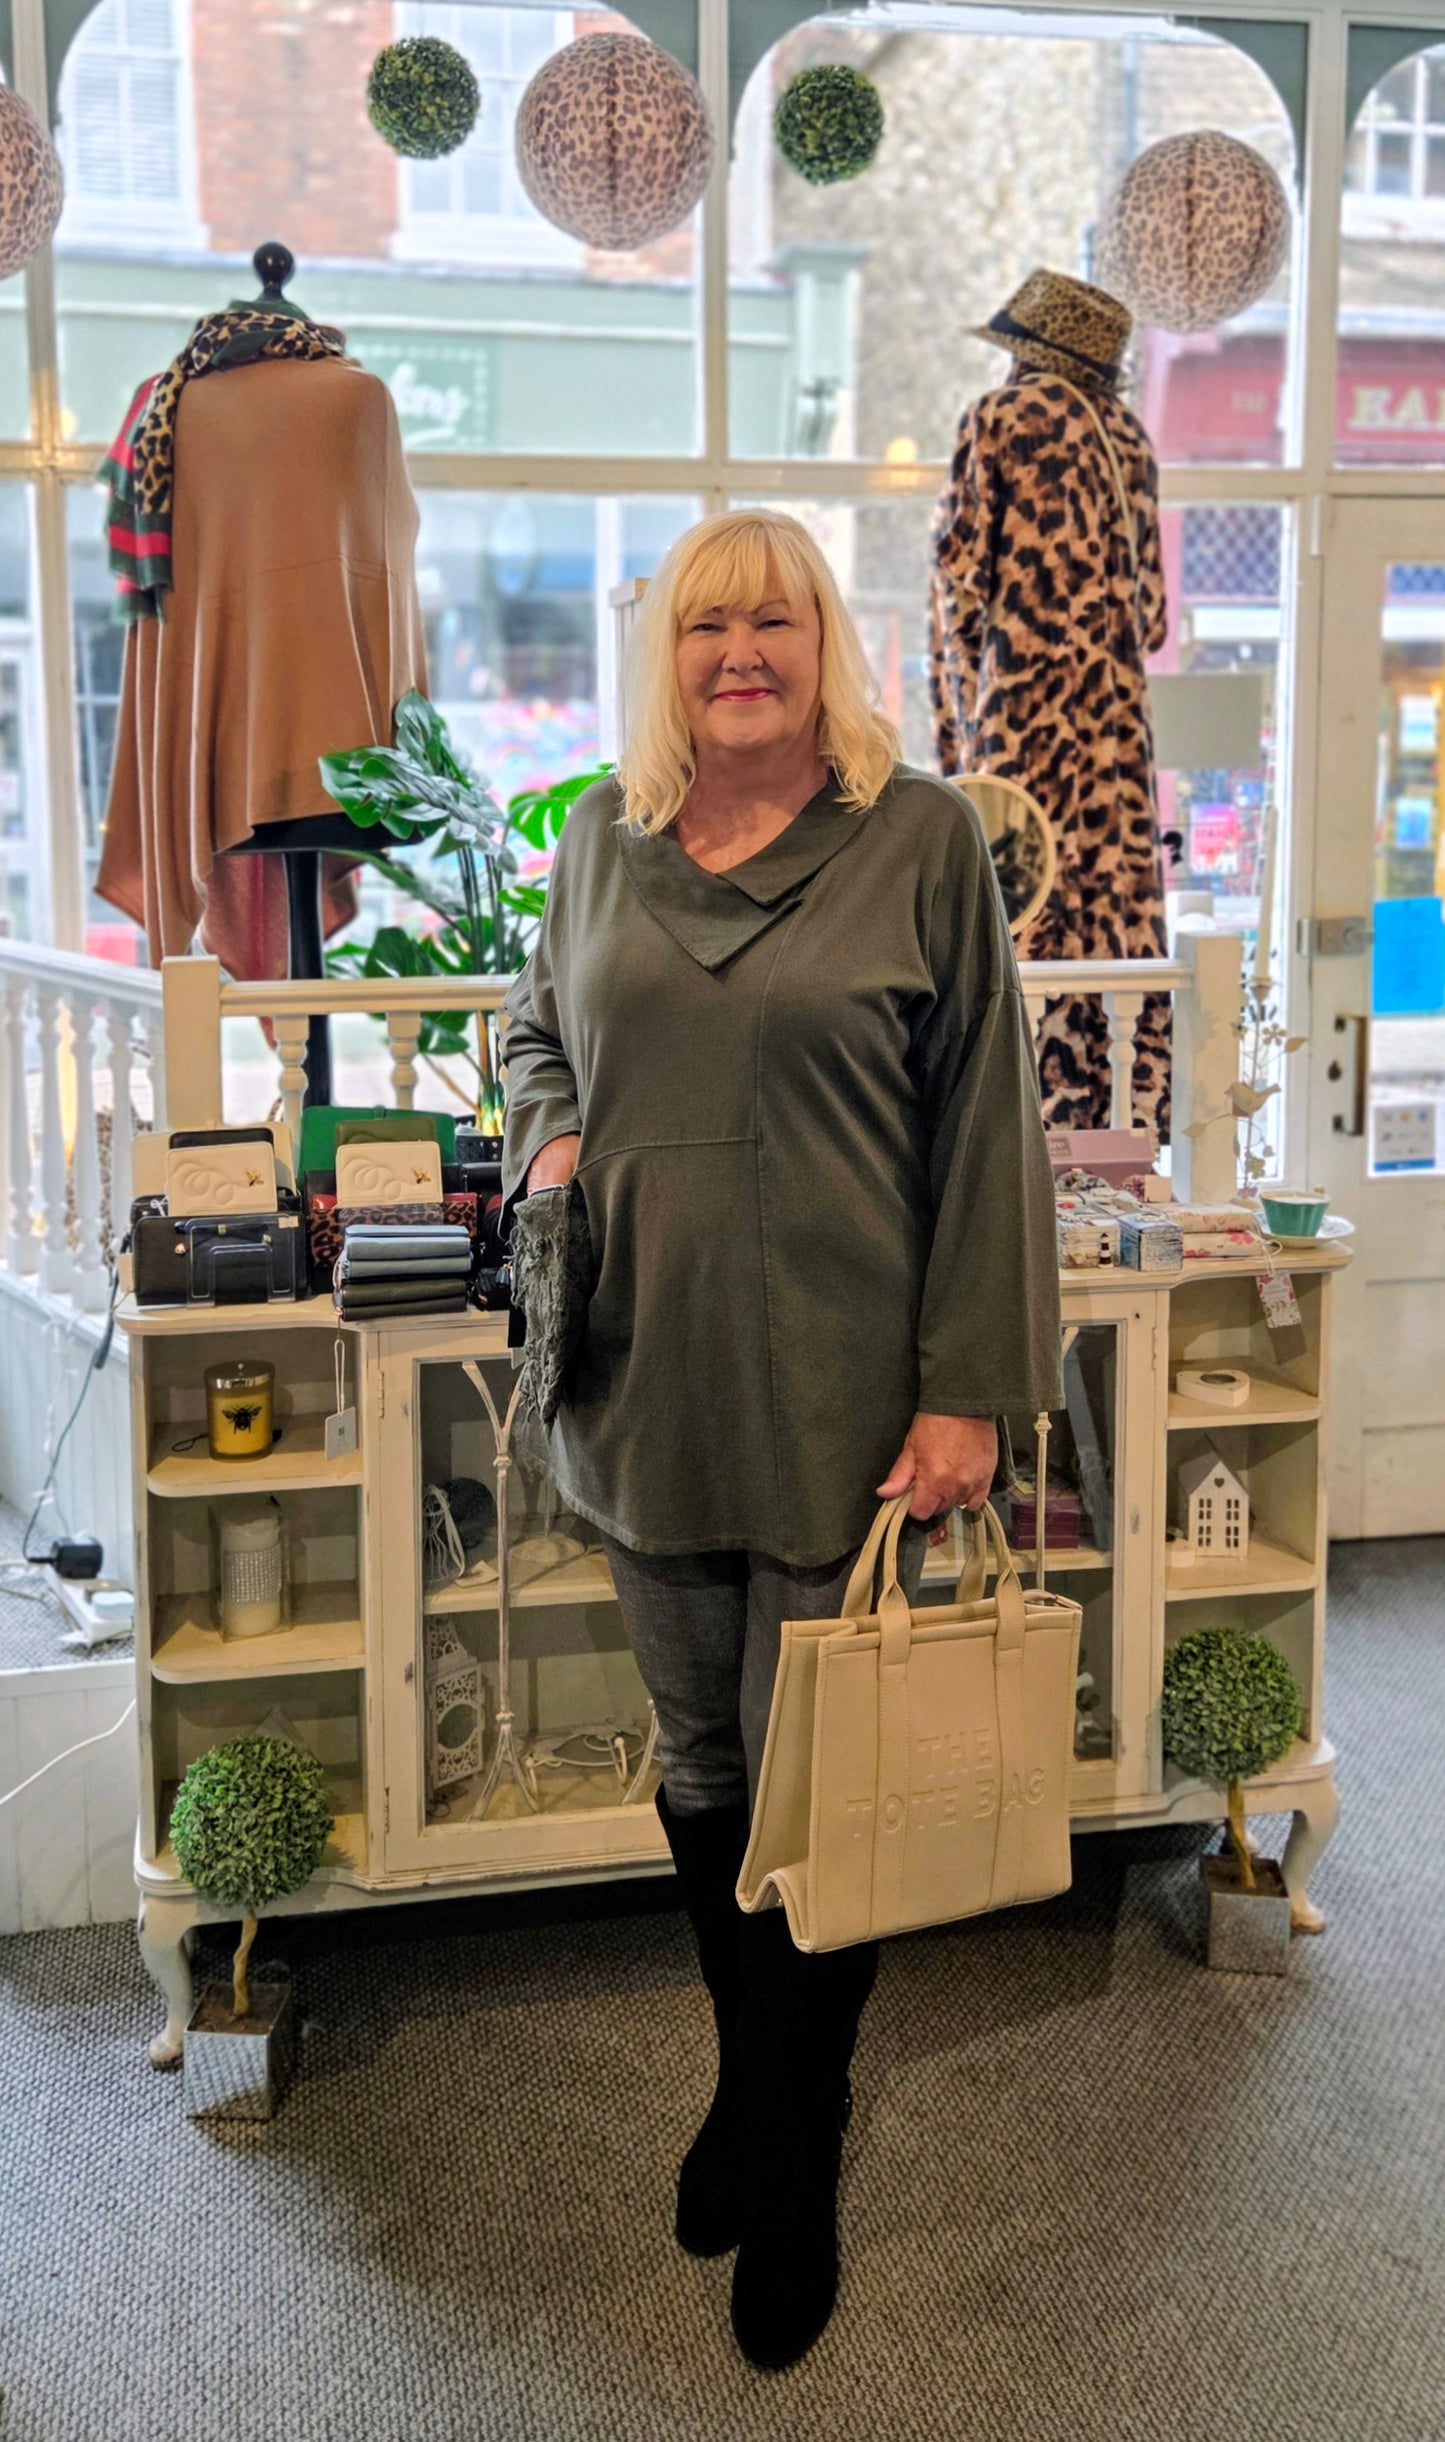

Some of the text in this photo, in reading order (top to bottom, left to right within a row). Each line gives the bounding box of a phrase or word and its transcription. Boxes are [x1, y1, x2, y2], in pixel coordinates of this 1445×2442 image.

[917, 1728, 992, 1778] THE
[846, 1767, 1045, 1838] TOTE BAG
